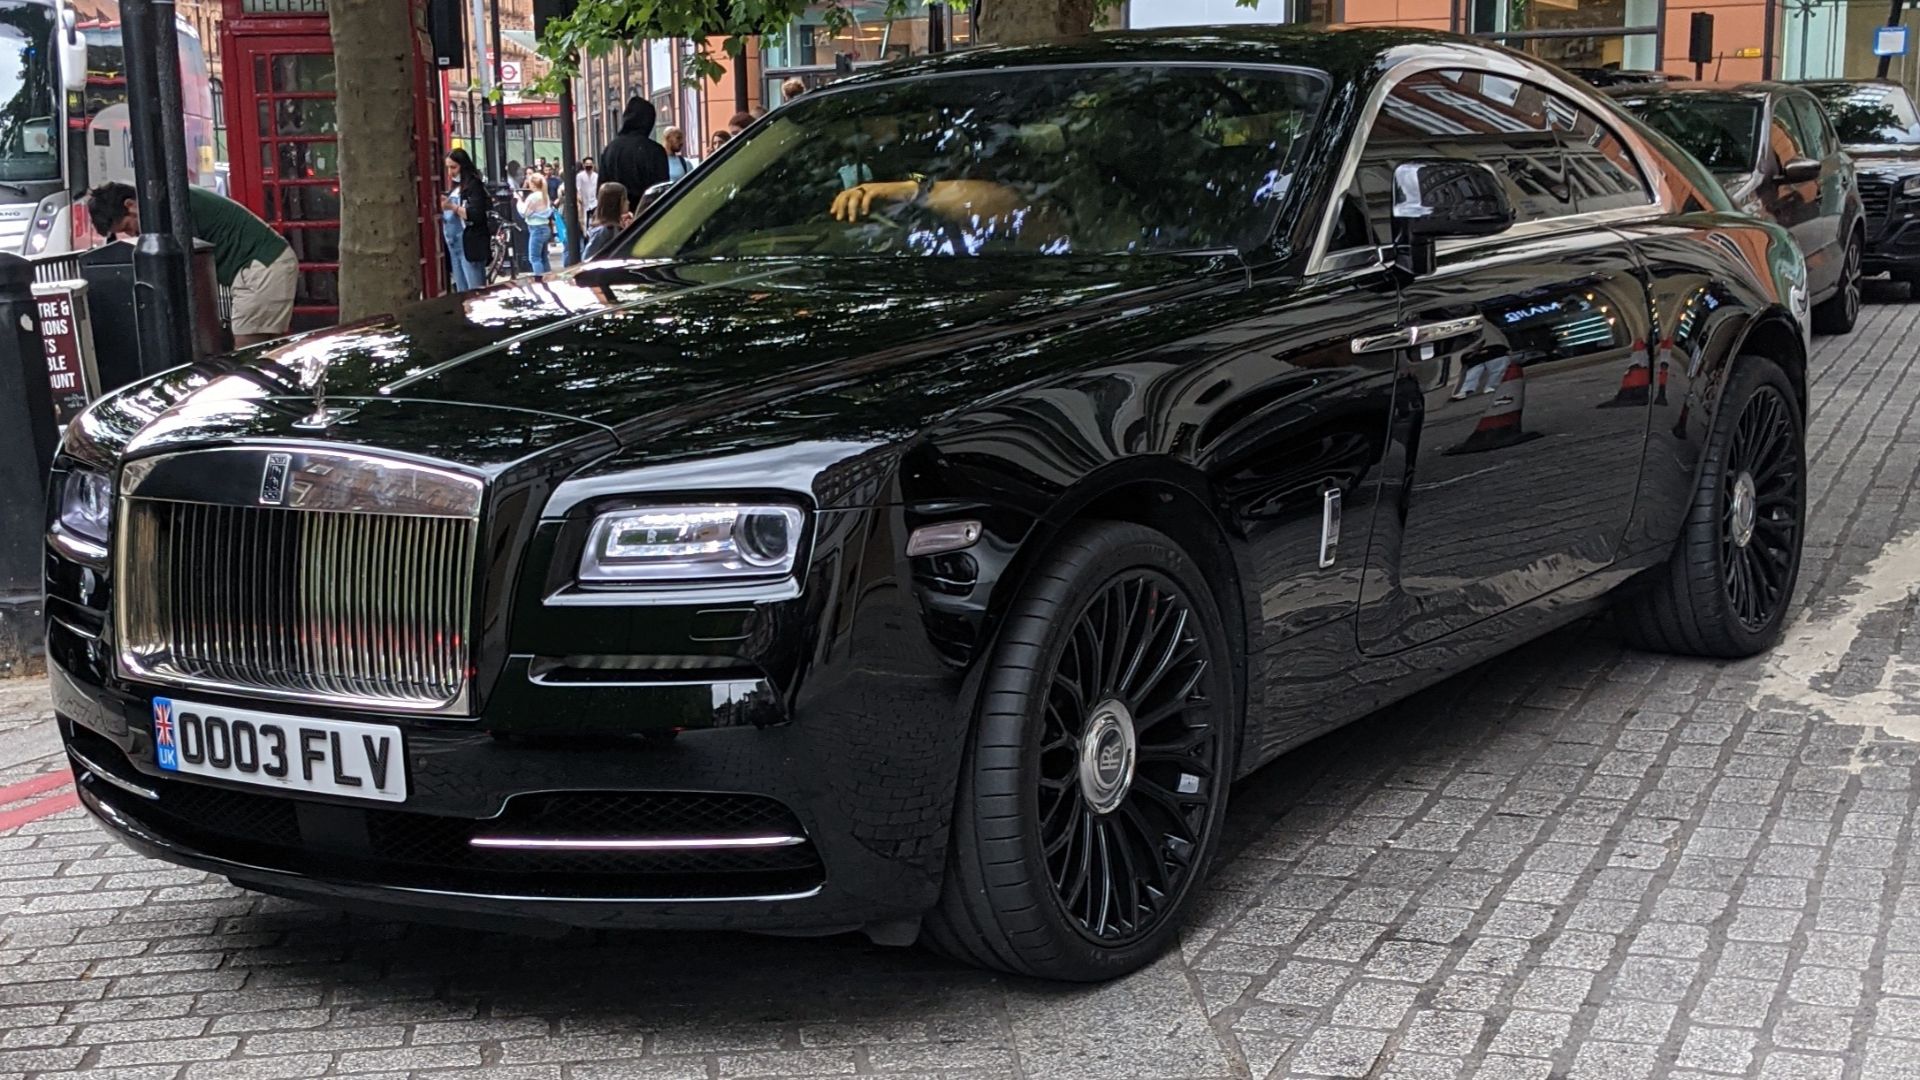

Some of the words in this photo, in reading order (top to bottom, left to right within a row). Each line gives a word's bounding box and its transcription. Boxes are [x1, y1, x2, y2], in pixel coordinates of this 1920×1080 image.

[61, 301, 70, 316] &
[159, 750, 175, 765] UK
[299, 727, 390, 789] FLV
